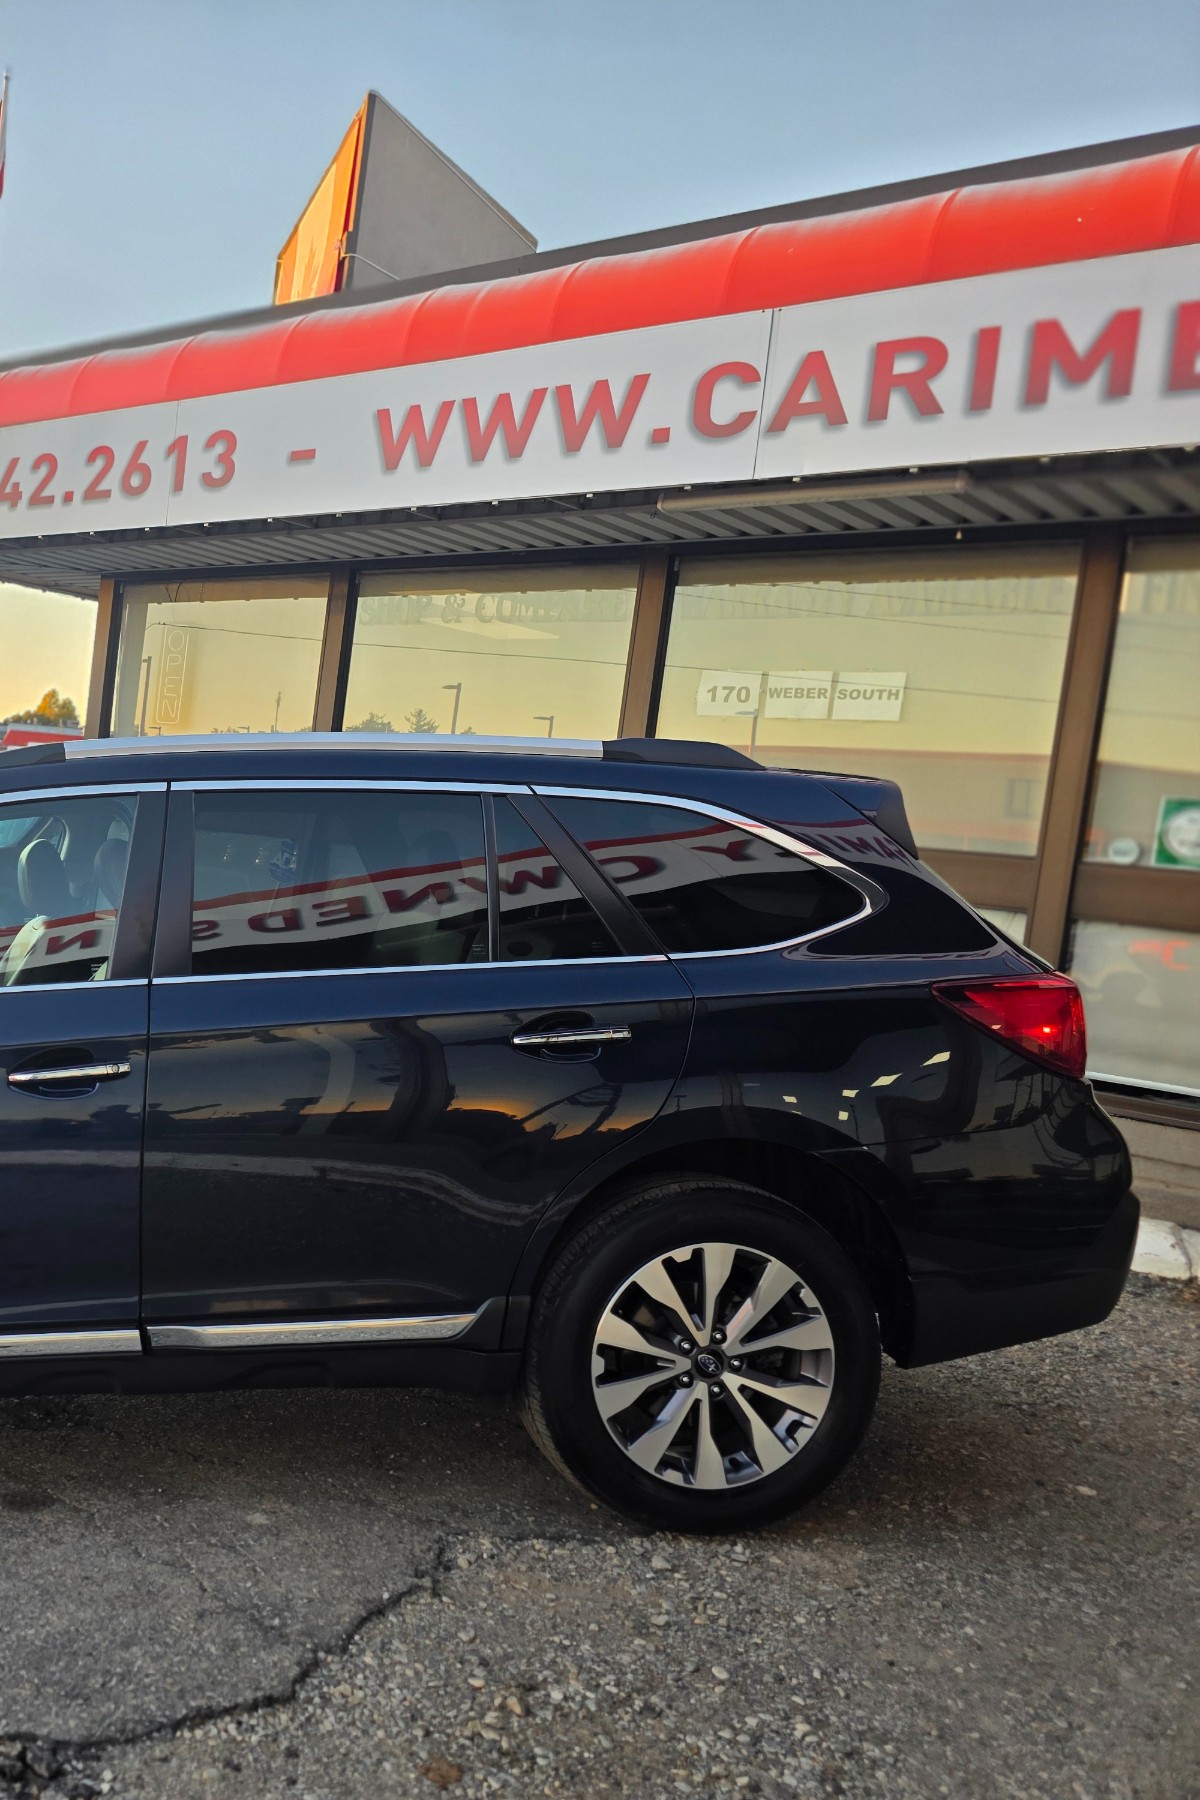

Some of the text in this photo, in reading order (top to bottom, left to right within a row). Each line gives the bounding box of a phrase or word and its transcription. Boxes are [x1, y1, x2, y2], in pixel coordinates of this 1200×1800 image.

[706, 685, 901, 704] 170 WEBER SOUTH
